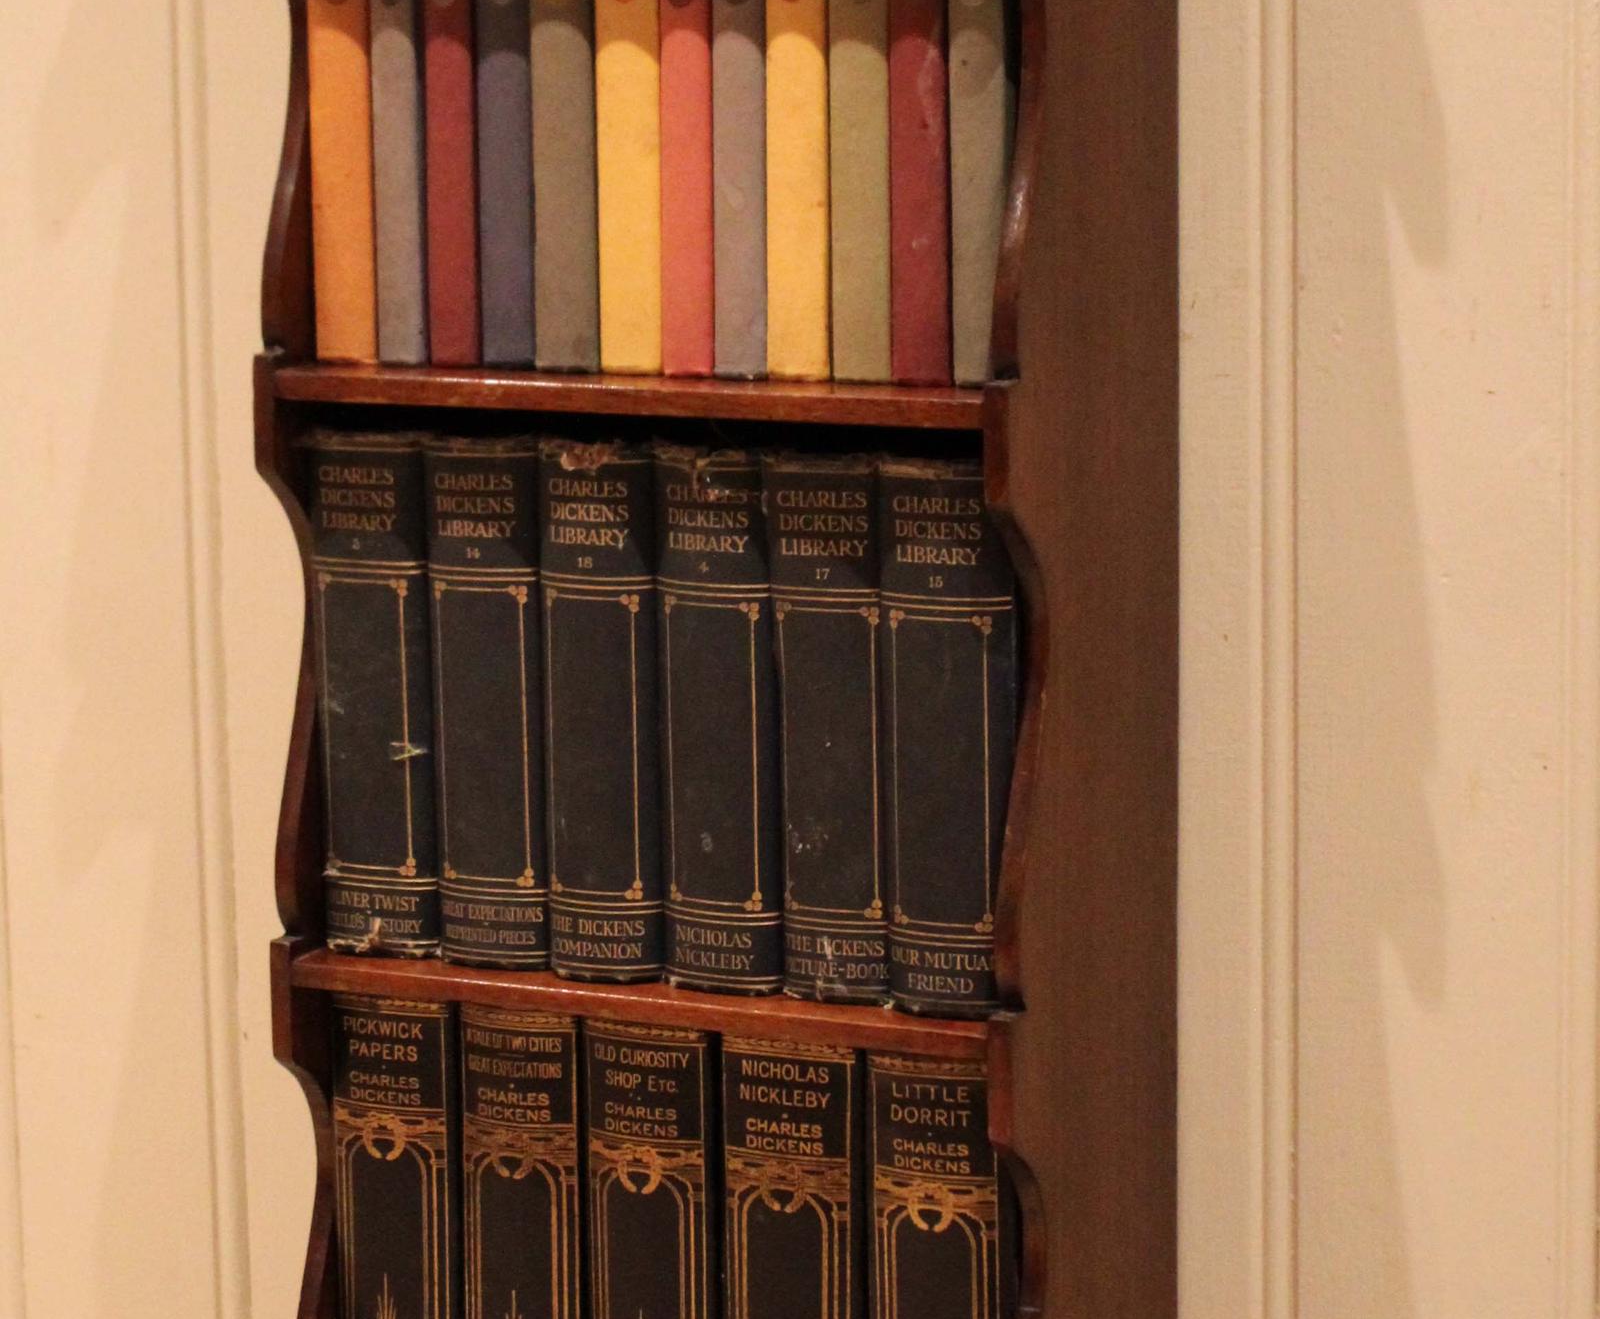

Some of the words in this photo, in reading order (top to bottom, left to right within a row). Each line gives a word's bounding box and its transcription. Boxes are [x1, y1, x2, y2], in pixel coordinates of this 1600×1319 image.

[318, 466, 394, 484] CHARLES
[434, 473, 514, 491] CHARLES
[320, 489, 396, 508] DICKENS
[550, 478, 628, 498] CHARLES
[436, 496, 515, 515] DICKENS
[777, 490, 867, 509] CHARLES
[893, 495, 981, 516] CHARLES
[321, 511, 397, 531] LIBRARY
[551, 503, 630, 523] DICKENS
[668, 507, 749, 528] DICKENS
[779, 514, 869, 533] DICKENS
[437, 519, 516, 539] LIBRARY
[550, 526, 630, 550] LIBRARY
[895, 519, 982, 541] DICKENS
[668, 532, 749, 554] LIBRARY
[780, 537, 868, 558] LIBRARY
[576, 555, 593, 570] 18
[896, 544, 981, 566] LIBRARY
[815, 567, 831, 581] 17
[372, 894, 420, 912] TWIST
[468, 903, 544, 924] EXPECTATIONS
[499, 928, 537, 946] PIECES
[578, 917, 646, 938] DICKENS
[675, 923, 752, 948] NICHOLAS
[554, 938, 643, 959] COMPANION
[815, 936, 885, 956] DICKENS
[675, 945, 755, 971] NICKLEBY
[907, 972, 975, 995] FRIEND
[343, 1015, 423, 1041] PICKWICK
[350, 1041, 418, 1063] PAPERS
[504, 1035, 526, 1052] TWO
[528, 1036, 562, 1053] CITIES
[594, 1042, 616, 1062] OLD
[619, 1048, 690, 1070] CURIOSITY
[350, 1069, 420, 1090] CHARLES
[493, 1059, 562, 1079] EXPECTATIONS
[604, 1068, 642, 1090] SHOP
[741, 1059, 830, 1084] NICHOLAS
[350, 1086, 422, 1106] DICKENS
[477, 1086, 551, 1107] CHARLES
[739, 1083, 832, 1109] NICKLEBY
[890, 1081, 971, 1104] LITTLE
[477, 1102, 551, 1123] DICKENS
[604, 1101, 678, 1122] CHARLES
[890, 1104, 972, 1128] DORRIT
[604, 1117, 679, 1138] DICKENS
[745, 1117, 824, 1138] CHARLES
[745, 1135, 825, 1156] DICKENS
[893, 1138, 970, 1158] CHARLES
[893, 1154, 972, 1175] DICKENS
